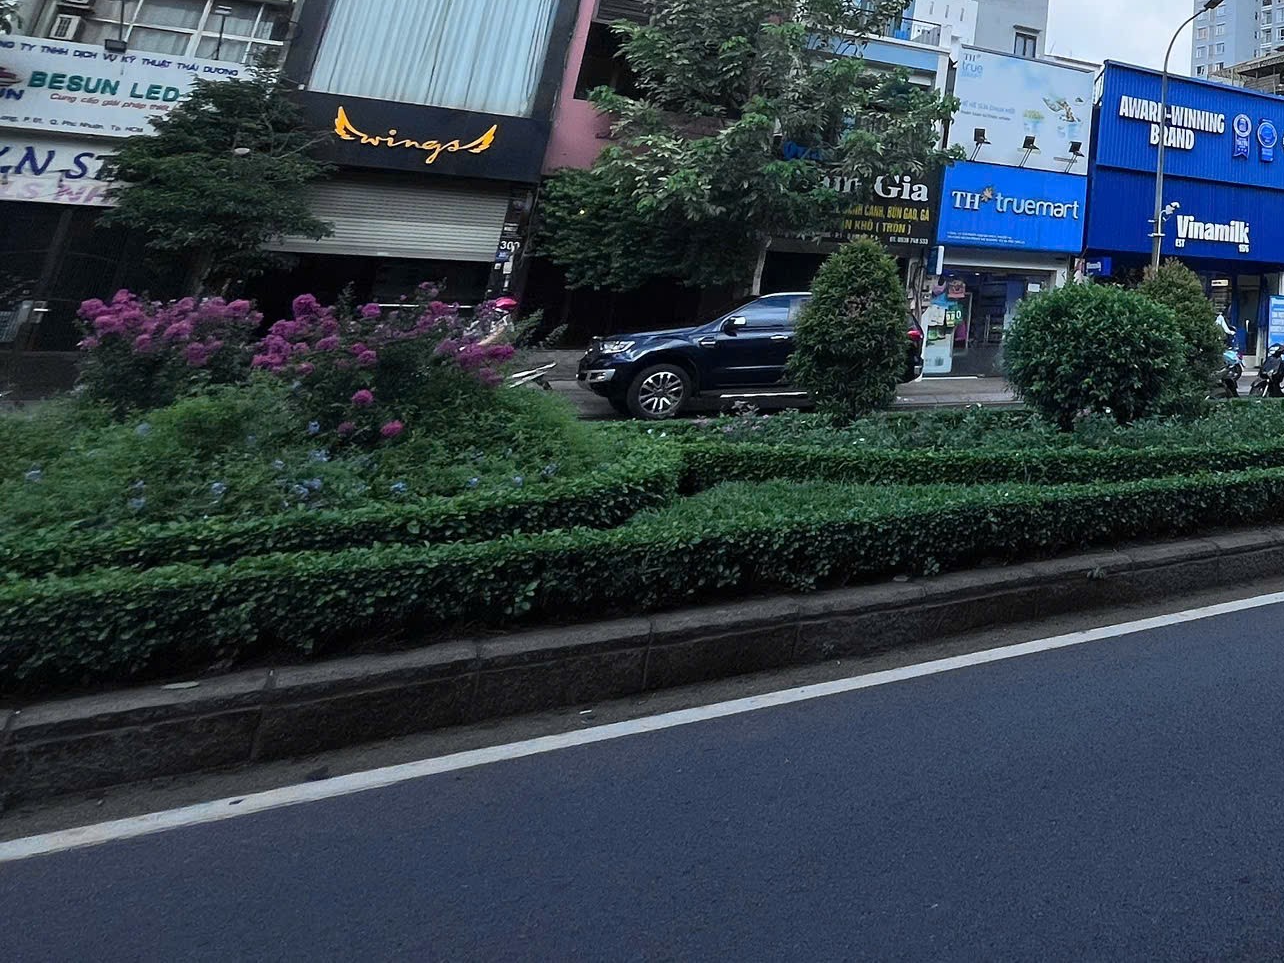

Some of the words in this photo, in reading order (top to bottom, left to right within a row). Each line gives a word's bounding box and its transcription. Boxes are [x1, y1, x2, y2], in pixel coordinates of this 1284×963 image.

[21, 43, 36, 51] TY
[41, 46, 69, 56] TNHH
[962, 61, 983, 74] true
[27, 70, 120, 96] BESUN
[130, 83, 180, 102] LED
[1119, 95, 1225, 134] AWARD-WINNING
[1150, 123, 1195, 150] BRAND
[874, 174, 929, 202] Gia
[952, 190, 982, 210] TH
[996, 192, 1080, 219] truemart
[1175, 238, 1186, 248] EST
[1177, 215, 1249, 244] Vinamilk
